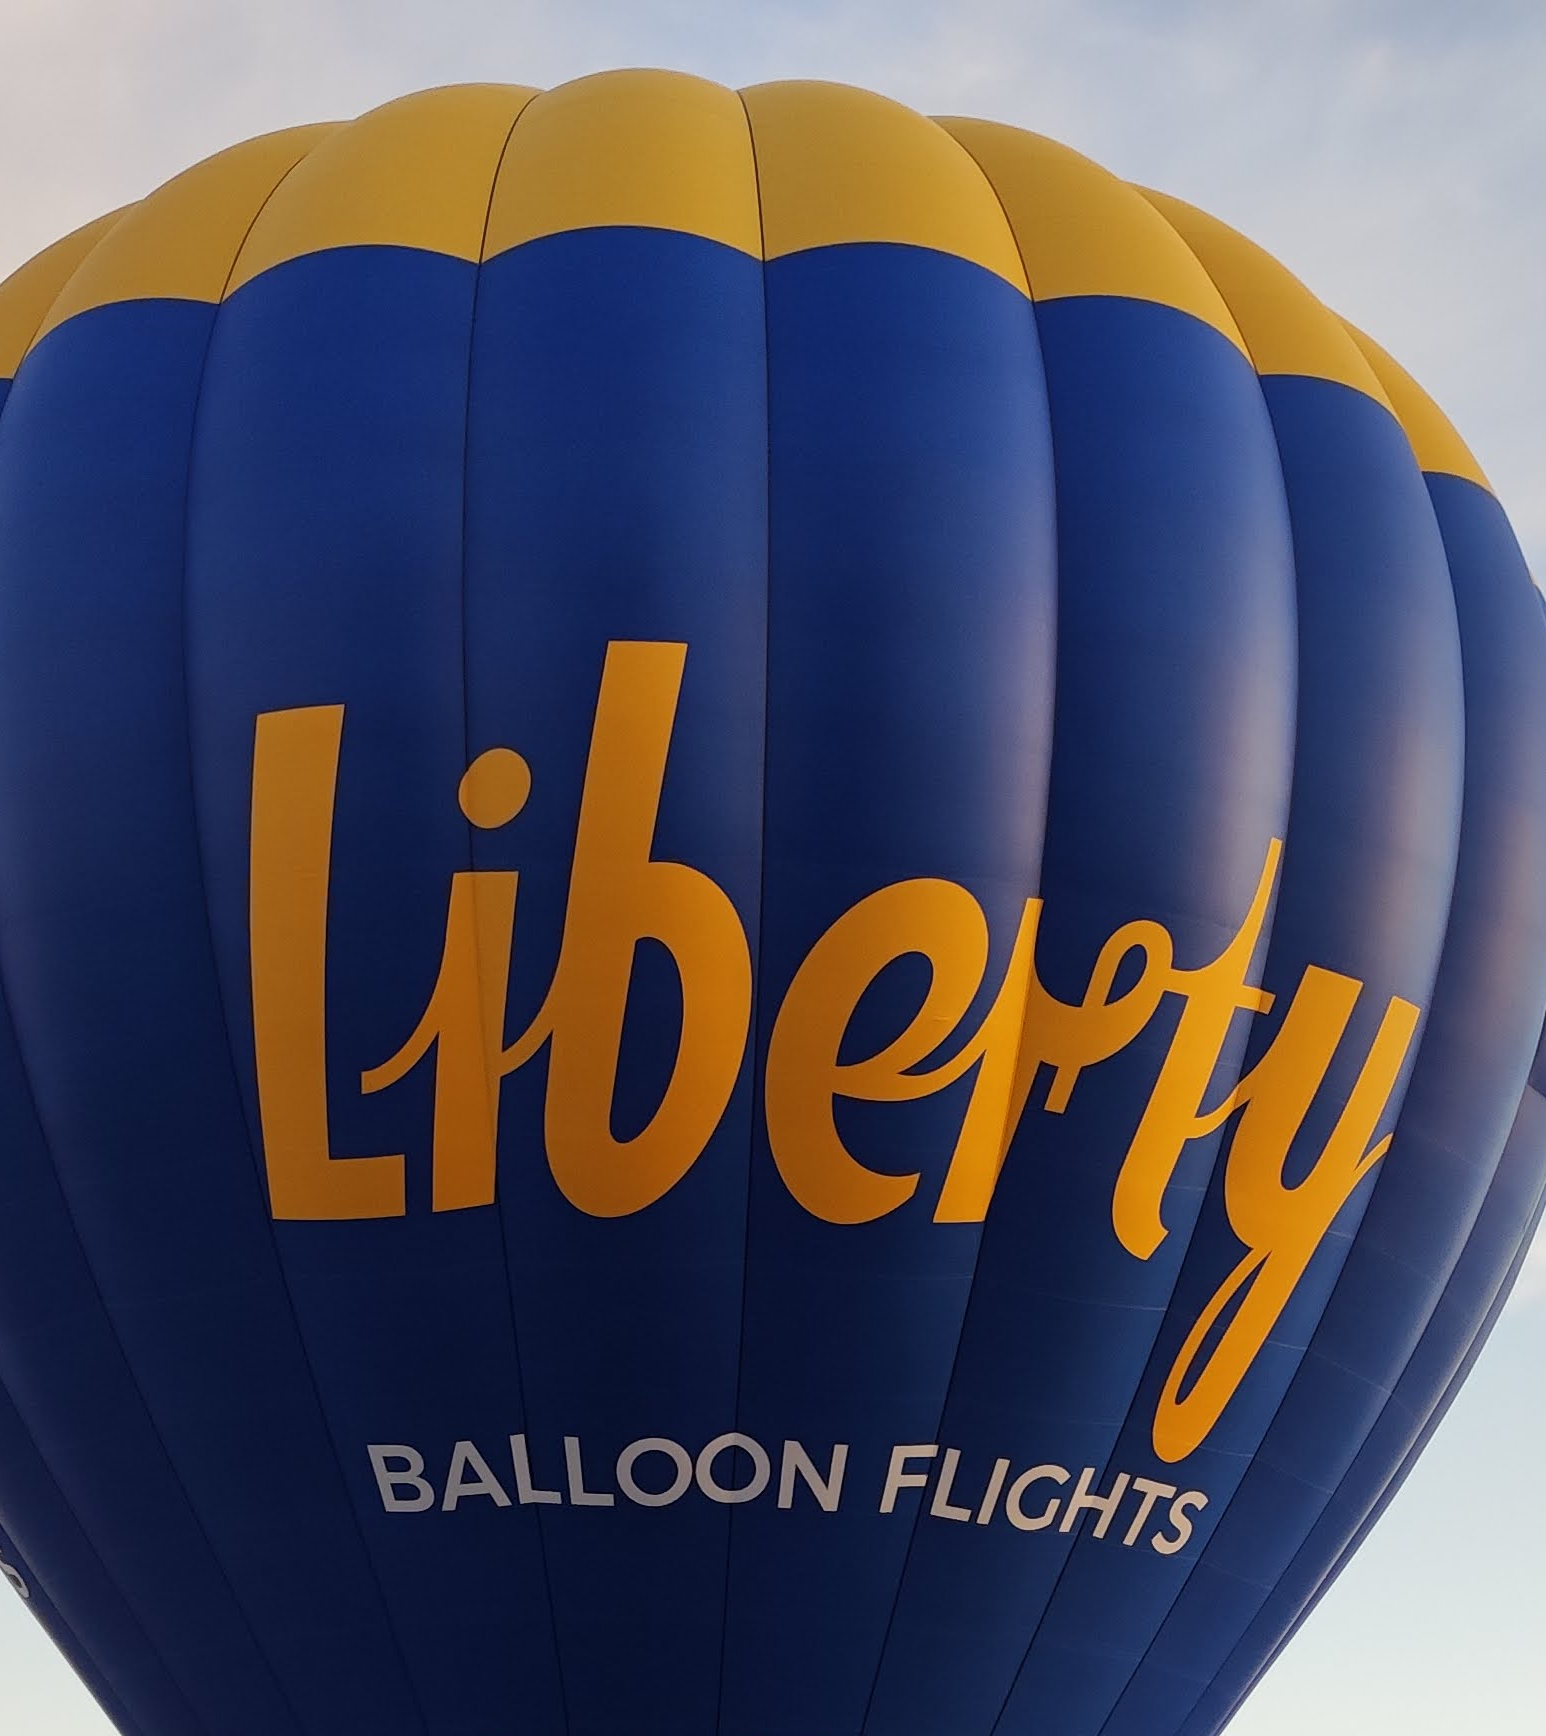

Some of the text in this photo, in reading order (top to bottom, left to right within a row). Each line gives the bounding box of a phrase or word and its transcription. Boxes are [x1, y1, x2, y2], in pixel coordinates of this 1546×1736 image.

[250, 641, 1420, 1463] Liberty
[367, 1433, 1209, 1554] BALLOON FLIGHTS
